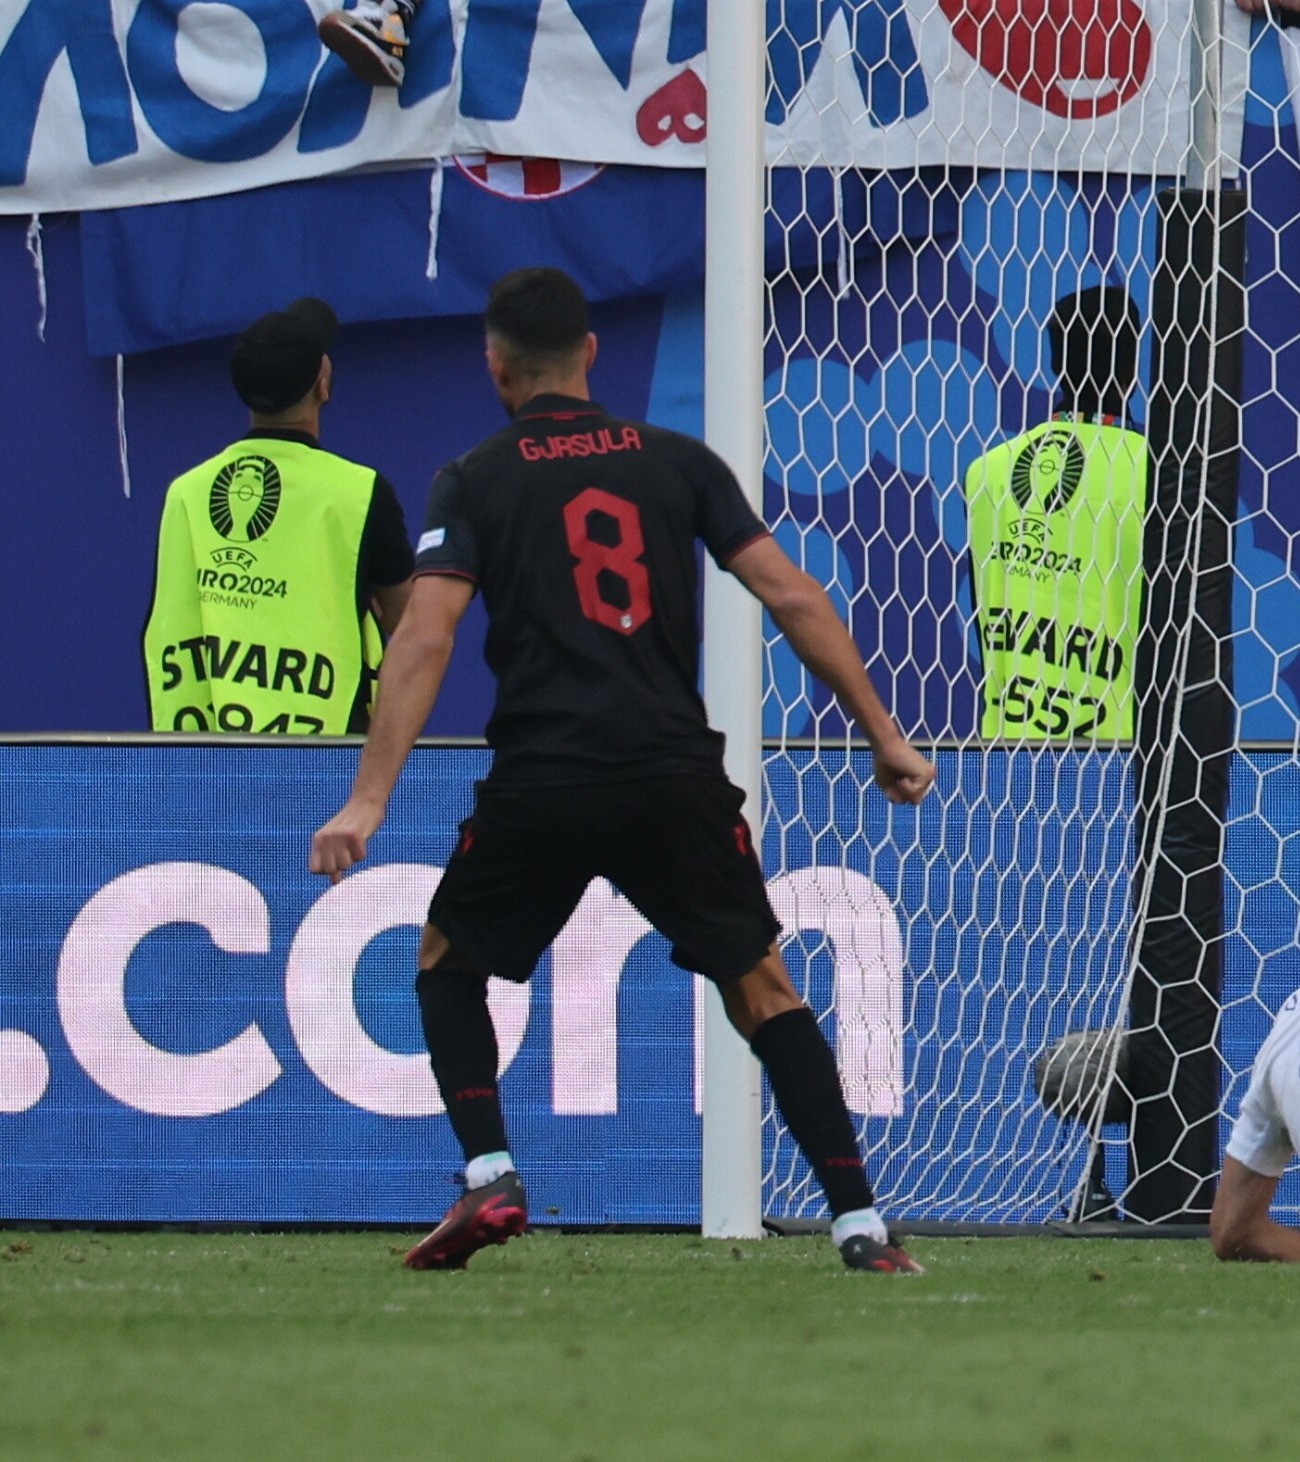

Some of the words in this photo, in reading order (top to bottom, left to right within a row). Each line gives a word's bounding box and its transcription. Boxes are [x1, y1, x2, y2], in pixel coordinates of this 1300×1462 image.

[518, 427, 642, 461] GJASULA
[211, 551, 254, 570] UEFA
[563, 487, 653, 636] 8
